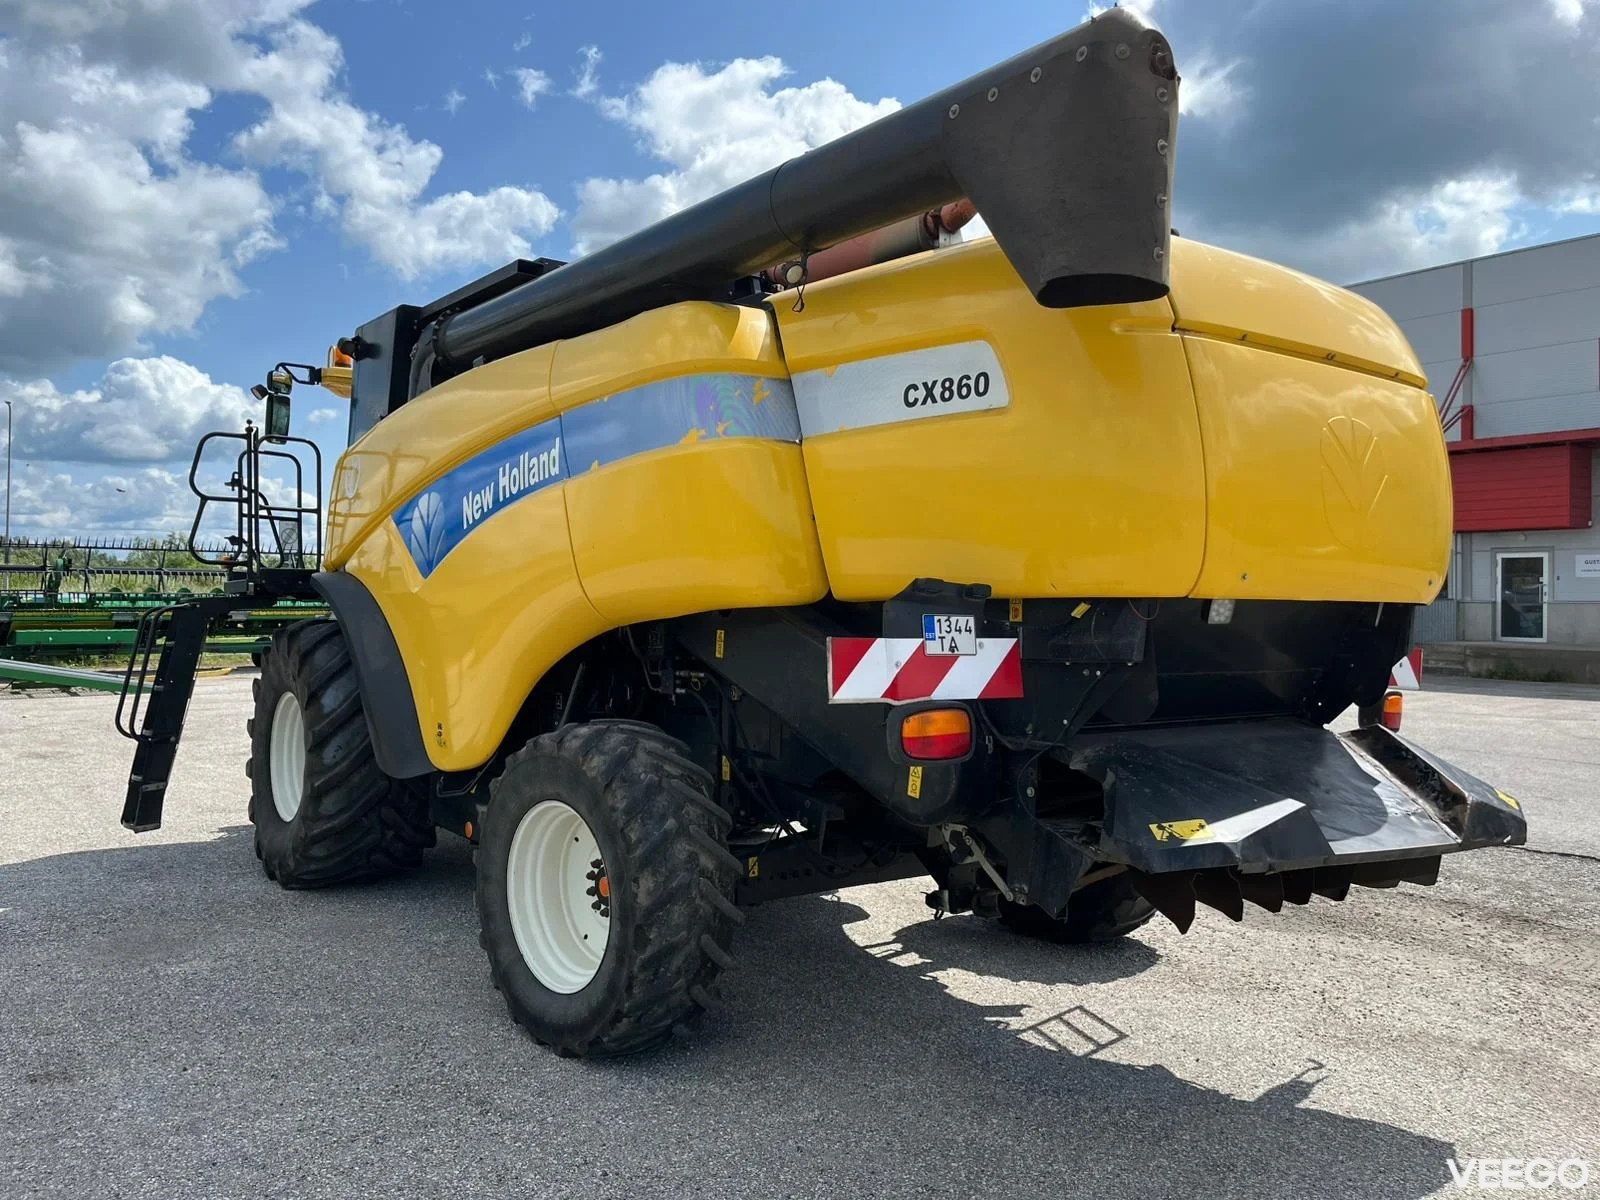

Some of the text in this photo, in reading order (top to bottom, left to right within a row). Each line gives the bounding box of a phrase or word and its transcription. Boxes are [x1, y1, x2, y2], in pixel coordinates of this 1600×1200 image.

[903, 371, 990, 408] CX860
[462, 437, 560, 530] New Holland
[937, 618, 972, 634] 1344
[938, 636, 959, 652] TA
